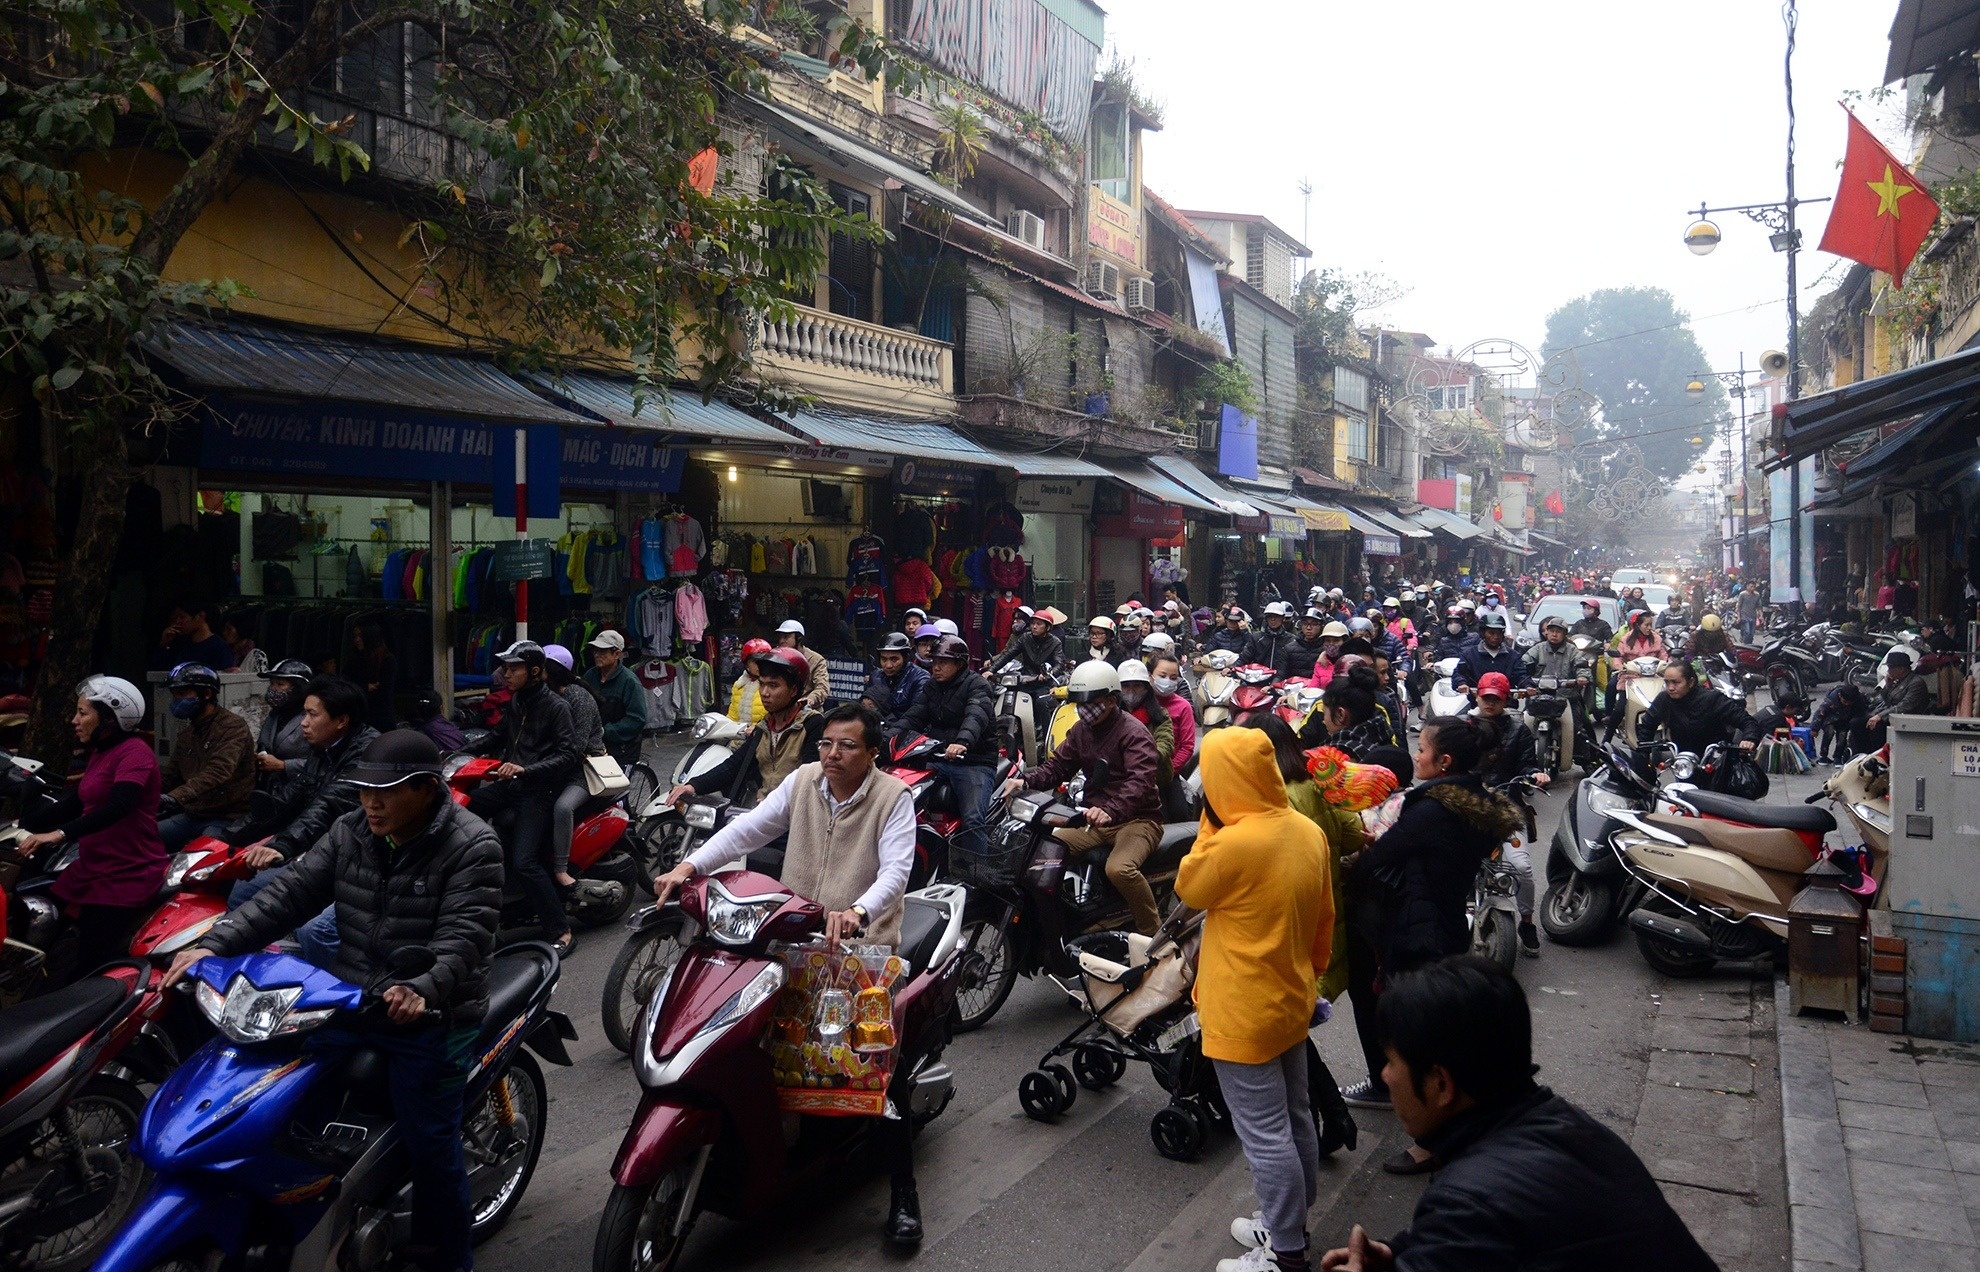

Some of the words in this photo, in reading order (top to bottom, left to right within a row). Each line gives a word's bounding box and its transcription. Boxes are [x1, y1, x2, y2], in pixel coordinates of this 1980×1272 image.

[320, 415, 376, 446] KINH
[382, 420, 456, 454] DOANH
[563, 434, 601, 467] MẶC
[609, 441, 648, 471] DỊCH
